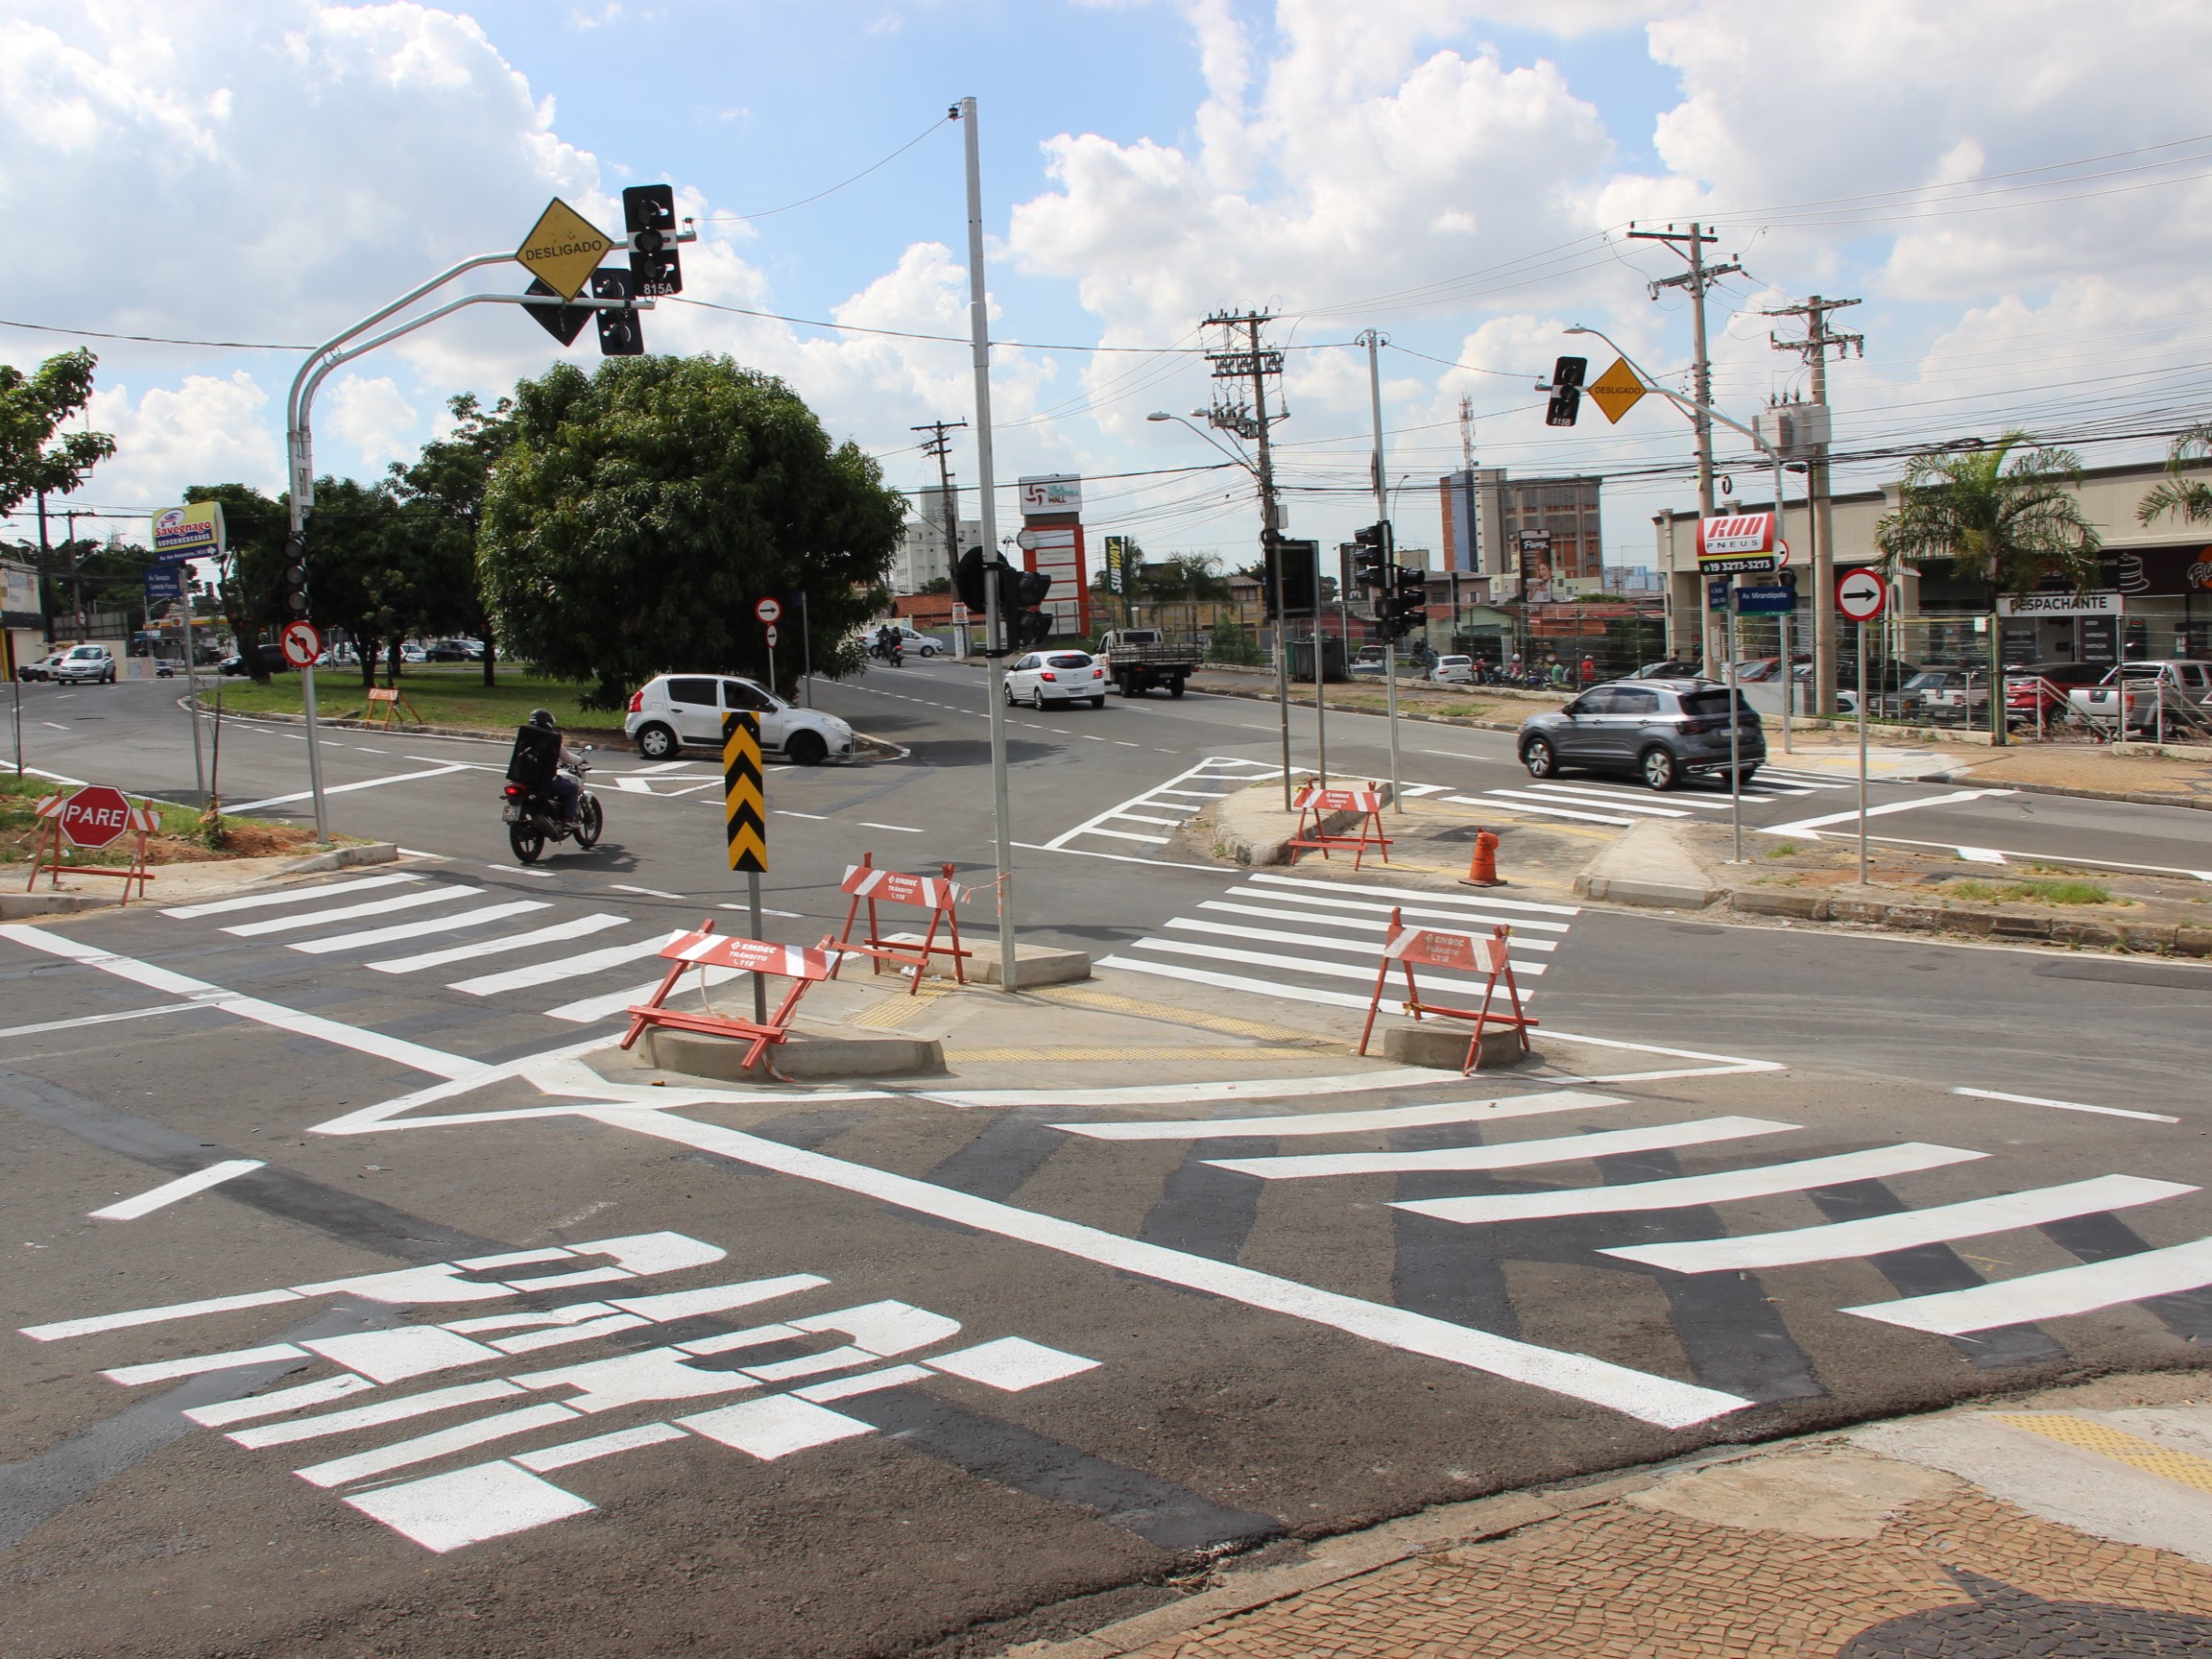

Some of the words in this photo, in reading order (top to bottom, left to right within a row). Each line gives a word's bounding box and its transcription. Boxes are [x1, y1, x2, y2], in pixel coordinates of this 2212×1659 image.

[525, 239, 602, 260] DESLIGADO
[643, 283, 674, 295] 815A
[1595, 386, 1641, 395] DESLIGADO
[1551, 417, 1572, 426] 815B
[155, 520, 211, 536] Savegnago
[157, 533, 210, 547] SUPERMERCADOS
[1706, 540, 1758, 549] PNEUS
[1108, 538, 1122, 594] SUBWAY
[1709, 563, 1719, 572] 19
[1721, 560, 1770, 571] 3273-3273
[1751, 591, 1788, 600] Mirandópolis
[65, 805, 125, 828] PARE
[895, 877, 918, 887] EMDEC
[1434, 935, 1465, 948] EMDEC
[741, 943, 778, 954] EMDEC
[19, 1231, 1103, 1554] PARE
